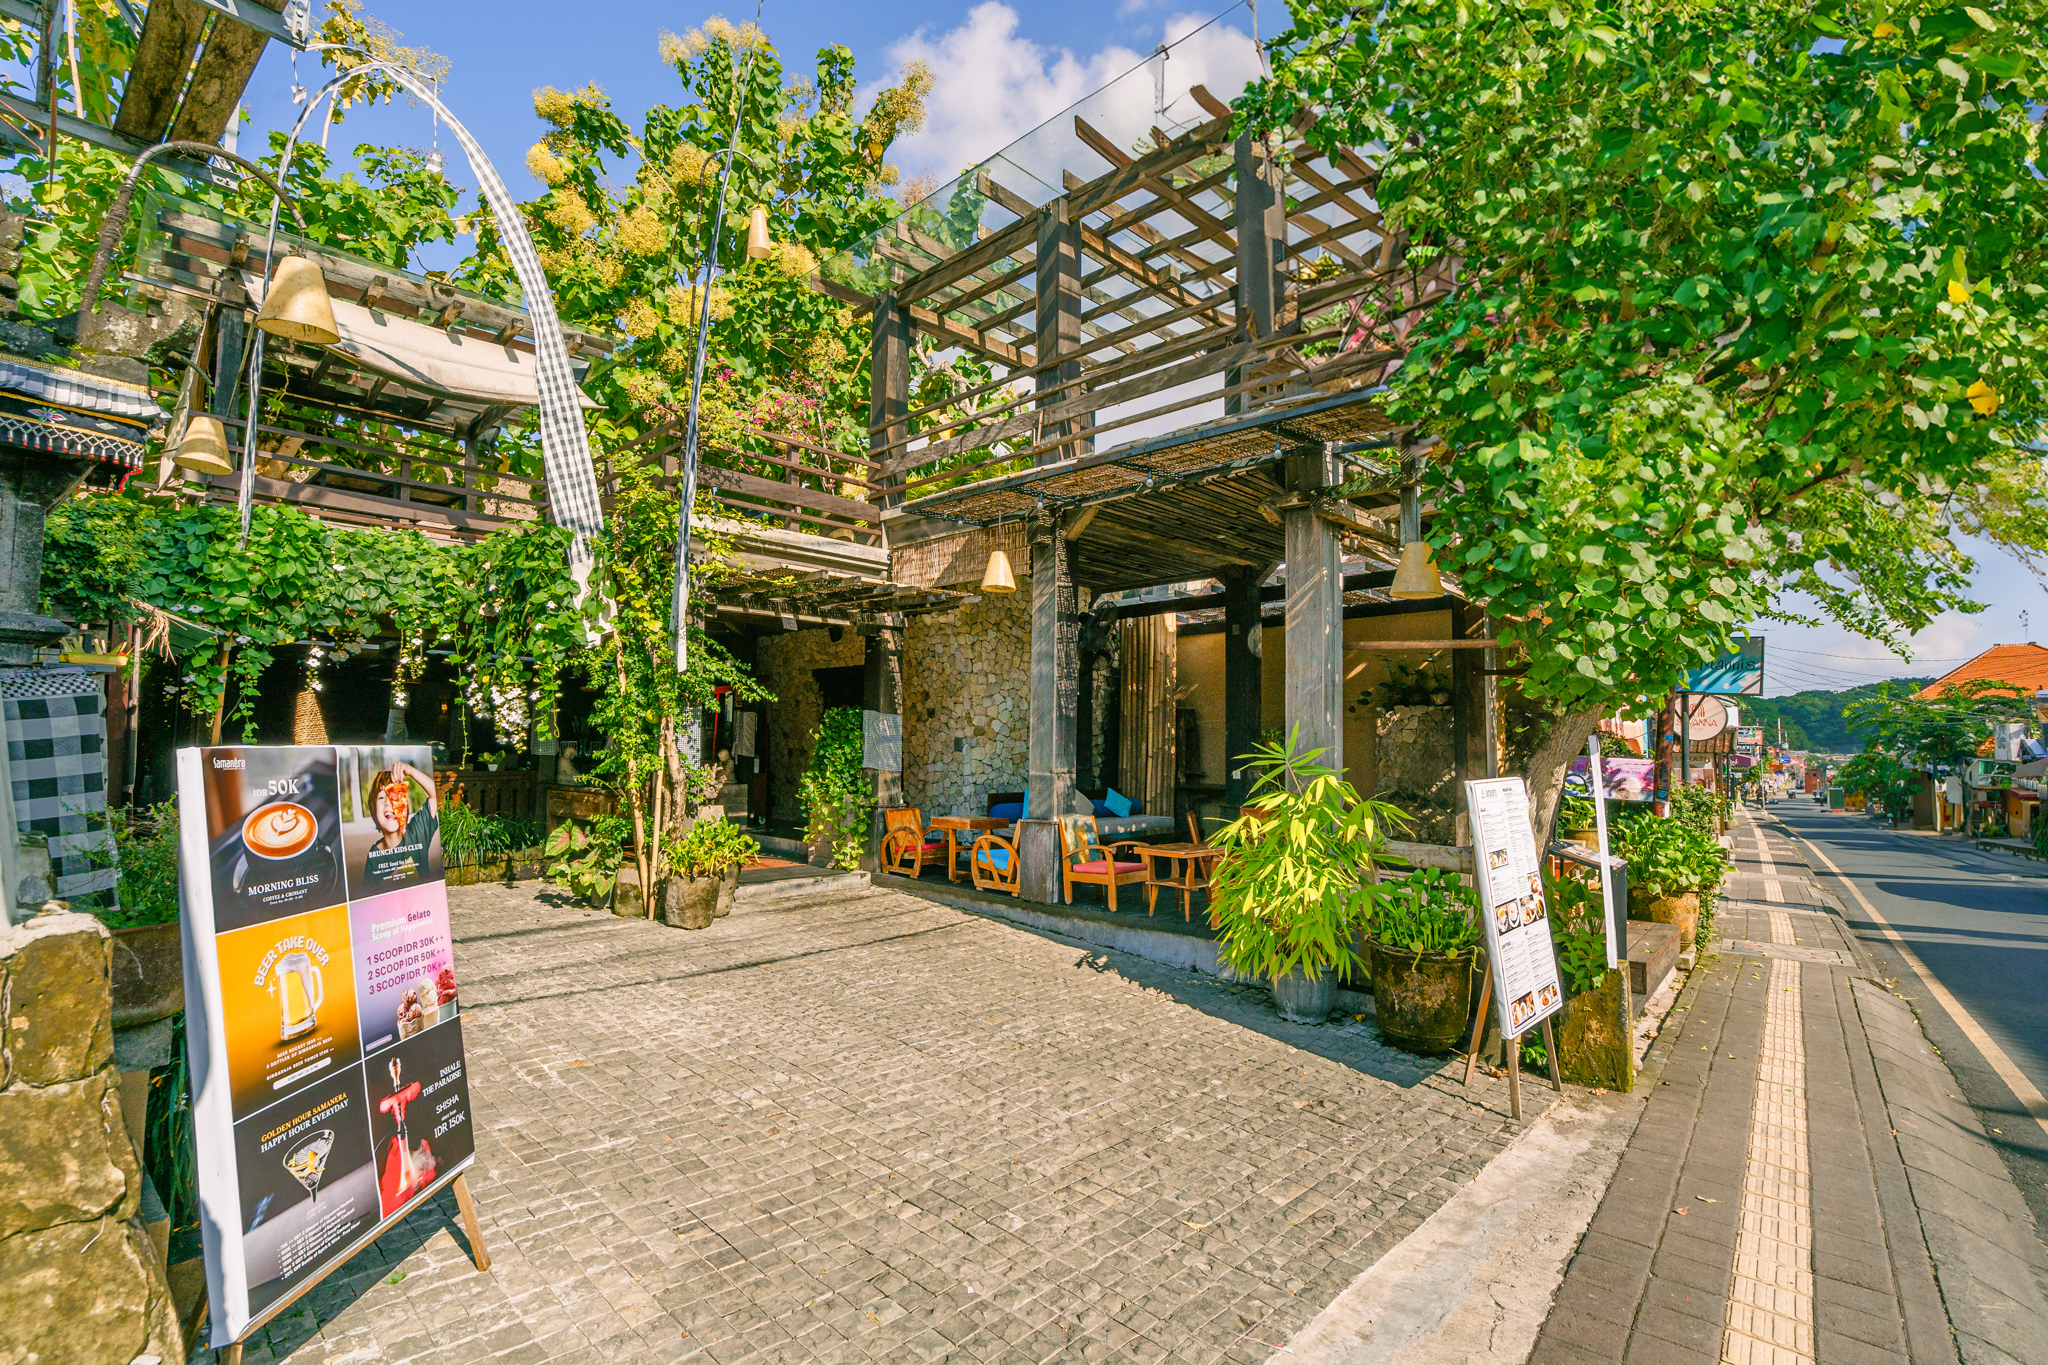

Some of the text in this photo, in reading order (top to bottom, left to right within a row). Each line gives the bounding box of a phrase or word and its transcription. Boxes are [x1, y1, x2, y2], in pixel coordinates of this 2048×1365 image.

[269, 779, 300, 795] 50K
[369, 848, 393, 858] BRUNCH
[248, 875, 319, 896] MORNING BLISS
[263, 894, 280, 902] COFFEE
[371, 910, 430, 933] Premium Gelato
[372, 917, 433, 941] Scoop of Happiness!
[254, 935, 330, 987] BEER TAKE OVER
[367, 956, 372, 965] 1
[373, 946, 402, 963] SCOOP
[404, 941, 418, 953] IDR
[368, 971, 373, 980] 2
[375, 960, 404, 978] SCOOP
[405, 955, 419, 967] IDR
[369, 985, 375, 995] 3
[376, 974, 406, 992] SCOOP
[406, 968, 420, 980] IDR
[270, 1055, 290, 1067] BOTTLES
[277, 1050, 288, 1058] BEER
[289, 1043, 305, 1053] BUCKET
[304, 1053, 318, 1063] TOWER
[440, 1060, 461, 1078] INHALE
[422, 1069, 462, 1097] THE PARADISE
[436, 1094, 459, 1114] SHISHA
[261, 1092, 347, 1142] GOLDEN HOUR SAMANERA
[261, 1098, 349, 1153] HAPPY HOUR EVERYDAY
[434, 1110, 465, 1138] IDR 150K
